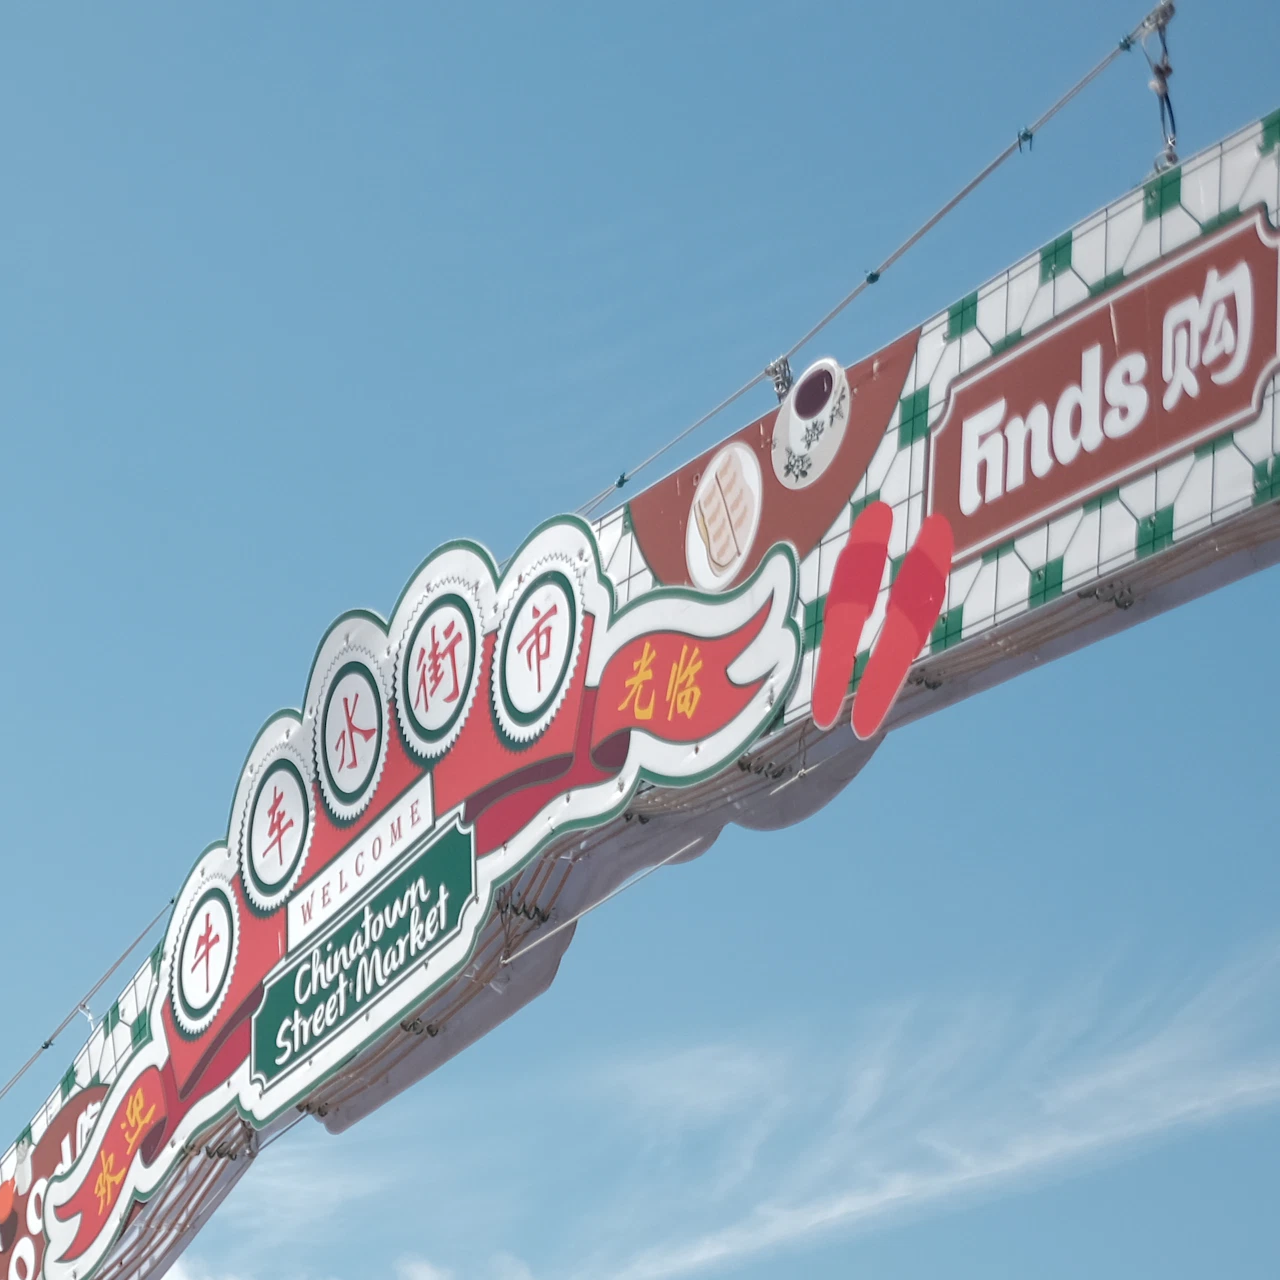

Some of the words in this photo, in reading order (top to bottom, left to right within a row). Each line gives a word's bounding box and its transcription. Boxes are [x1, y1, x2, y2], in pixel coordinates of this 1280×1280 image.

[1162, 258, 1254, 412] 购
[617, 641, 703, 722] 光临
[191, 604, 558, 994] 牛车水街市
[300, 799, 422, 927] WELCOME
[274, 972, 349, 1066] Street
[355, 883, 449, 1003] Market
[293, 875, 431, 1005] Chinatown
[94, 1087, 156, 1216] 欢迎
